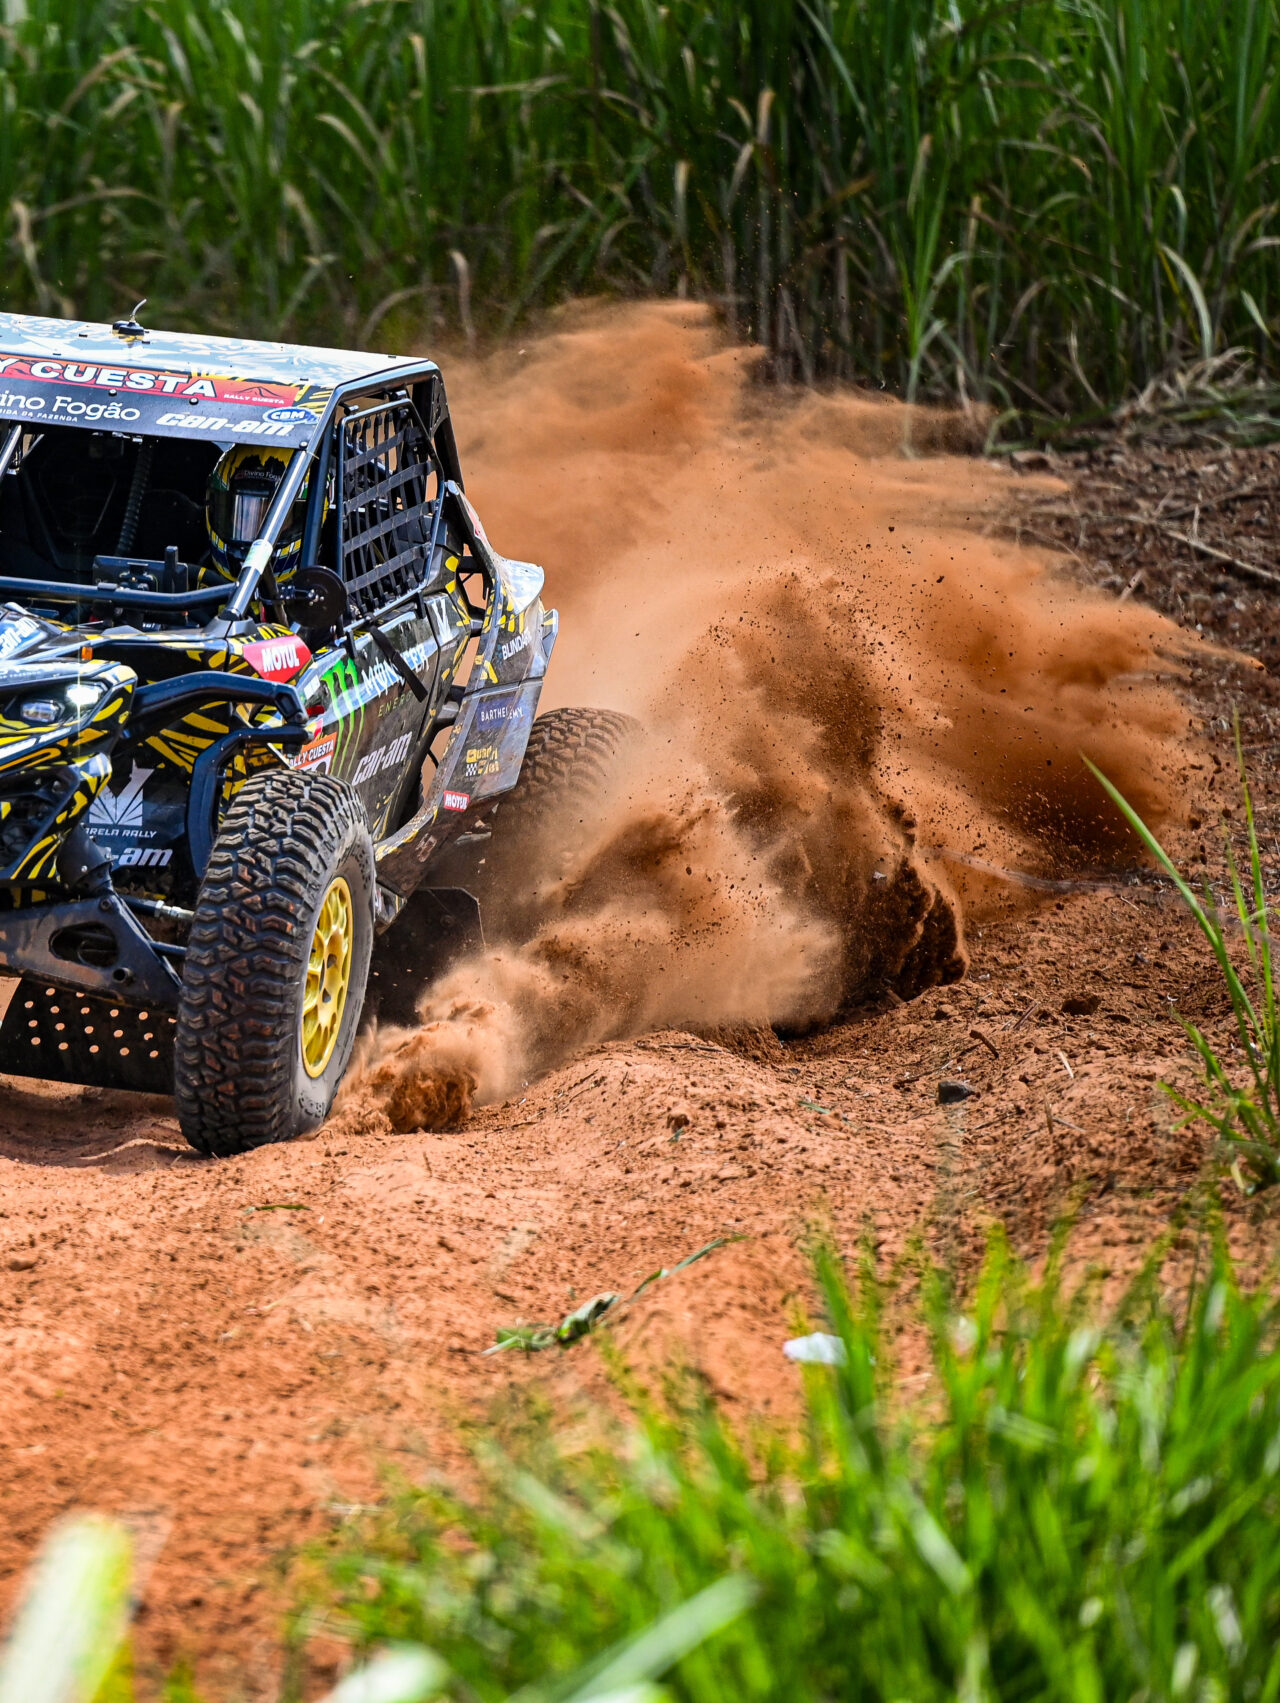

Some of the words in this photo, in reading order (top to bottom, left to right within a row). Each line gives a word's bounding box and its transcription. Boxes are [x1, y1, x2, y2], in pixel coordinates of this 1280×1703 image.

[30, 361, 217, 398] CUESTA
[52, 396, 141, 421] Fogão
[223, 393, 250, 401] RALLY
[252, 396, 285, 405] CUESTA
[37, 412, 78, 422] FAZENDA
[156, 412, 295, 437] can-am
[261, 643, 300, 673] MOTUL
[361, 643, 430, 698] MONTER
[377, 690, 413, 718] ENERG
[308, 739, 334, 760] CUESTA
[352, 731, 413, 786] can-am
[445, 793, 468, 809] MOTUL
[85, 827, 120, 837] ARELA
[122, 829, 158, 839] RALLY
